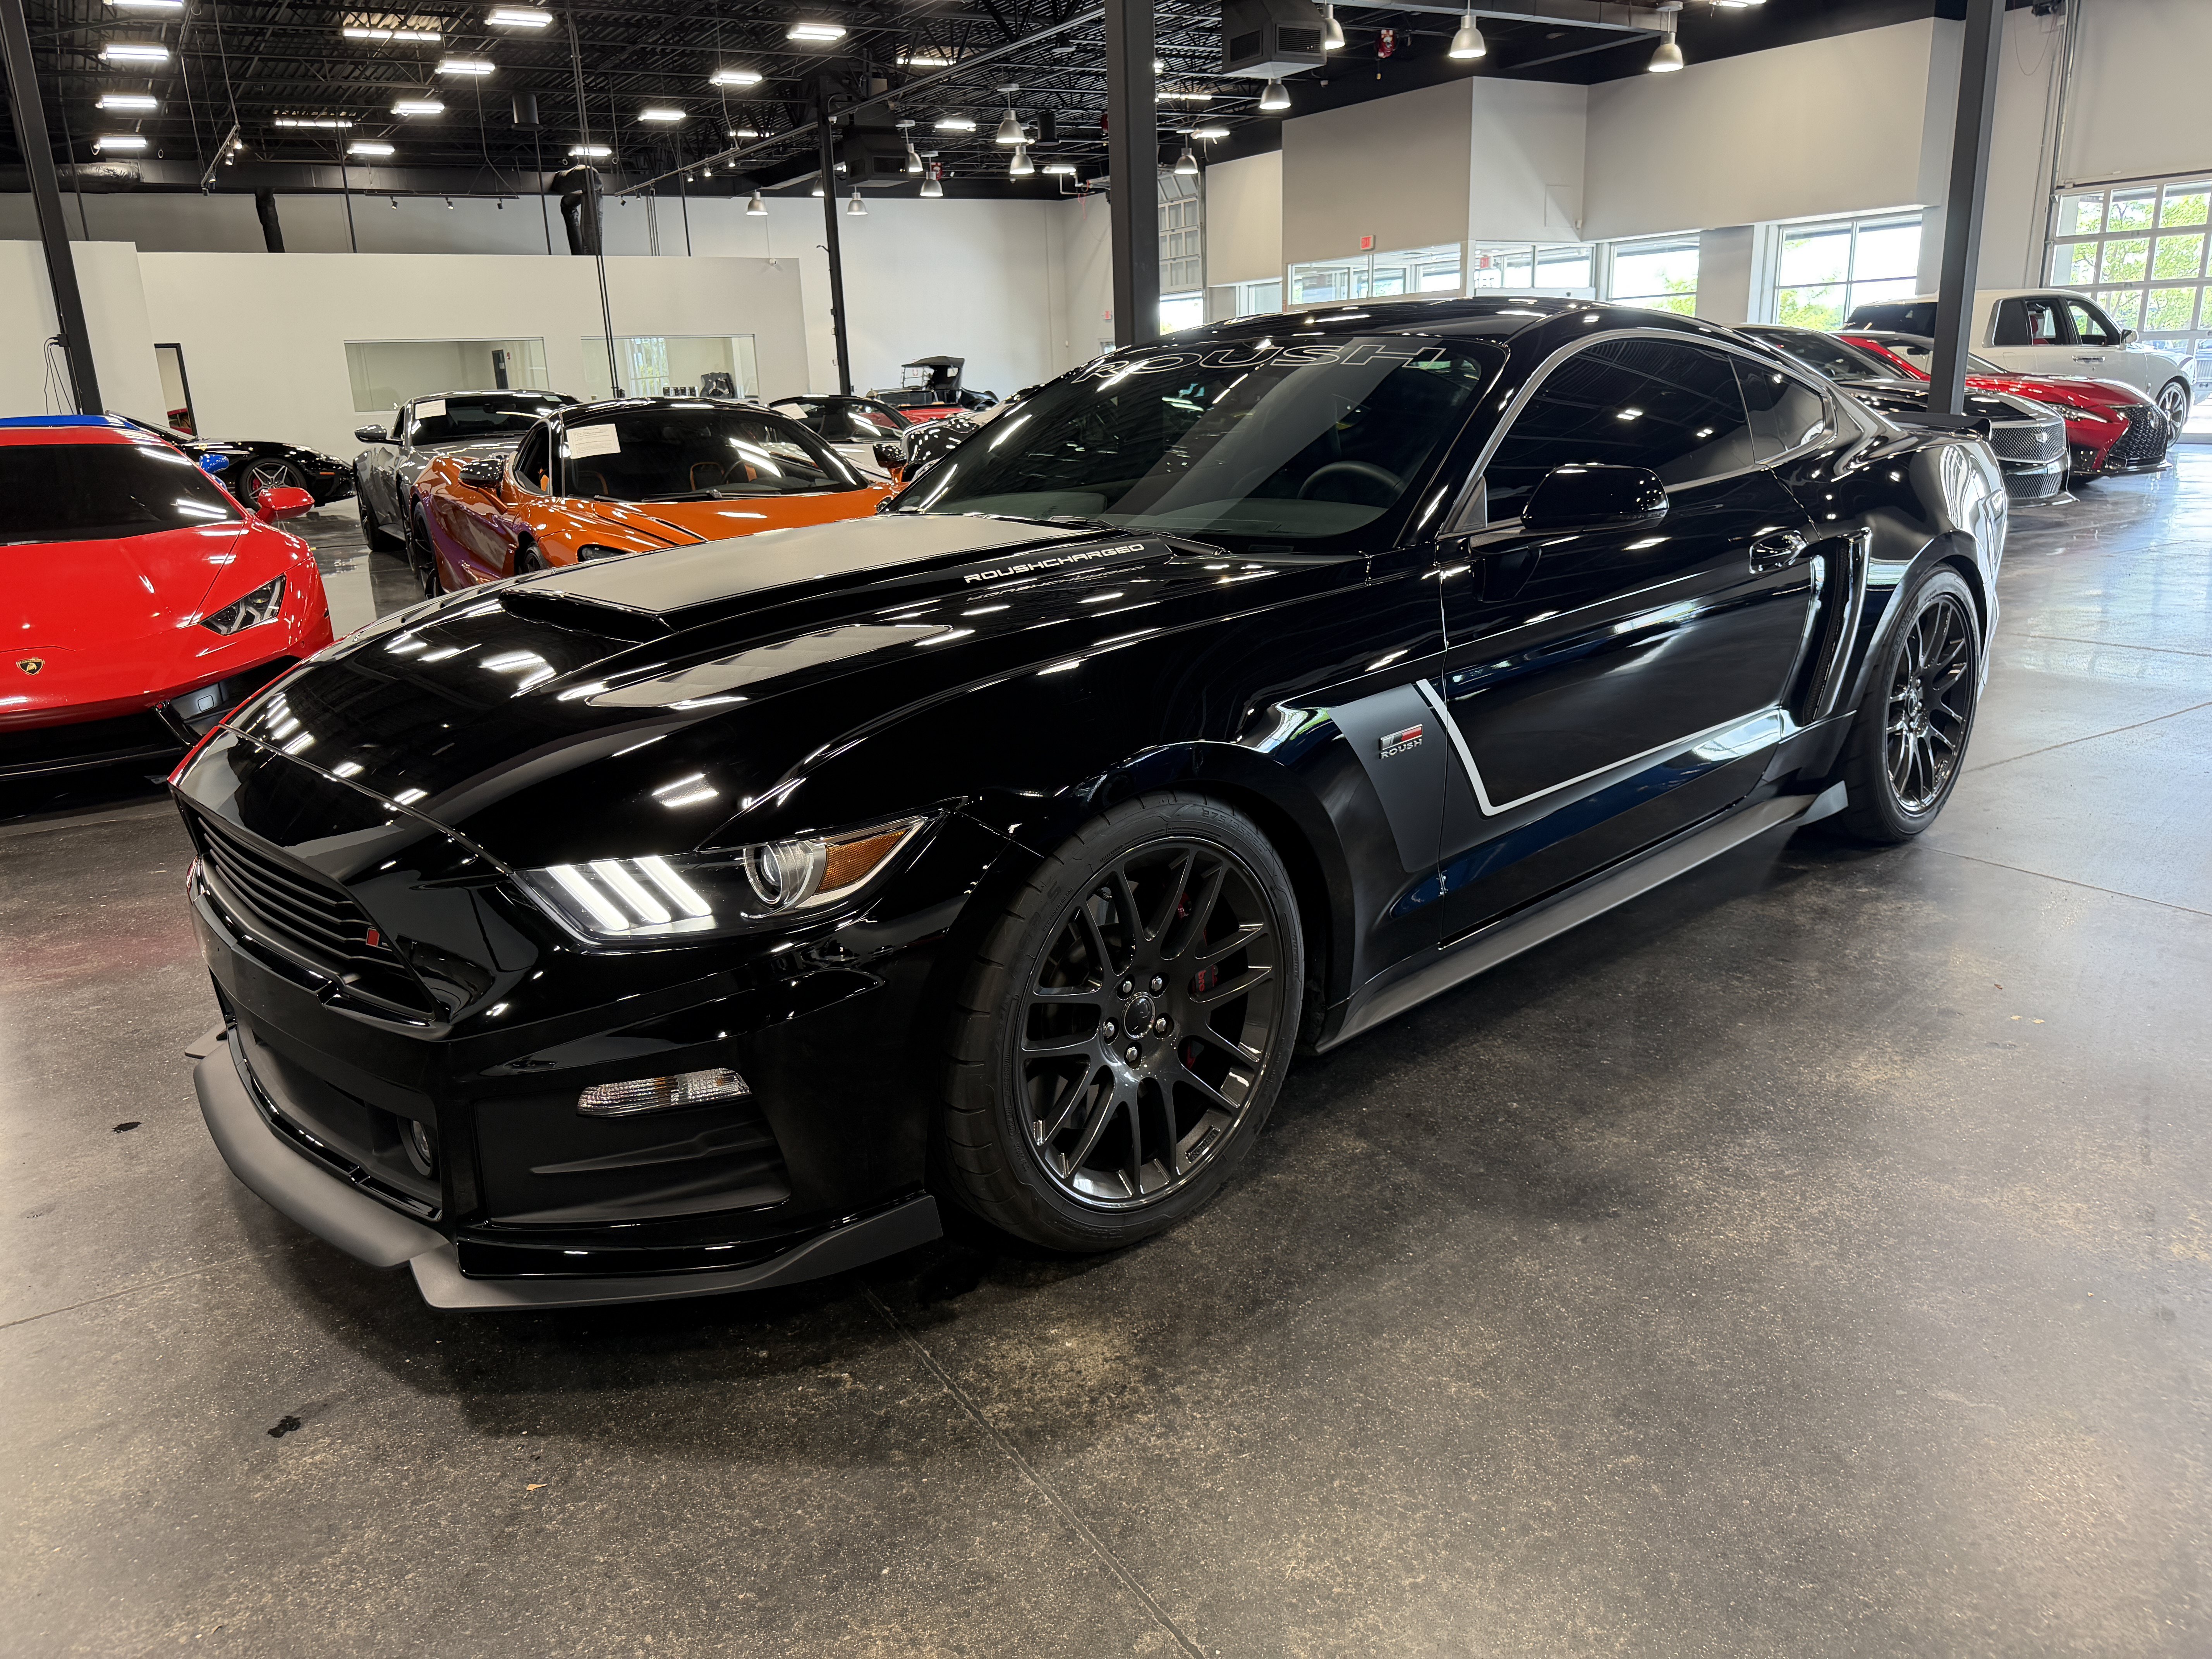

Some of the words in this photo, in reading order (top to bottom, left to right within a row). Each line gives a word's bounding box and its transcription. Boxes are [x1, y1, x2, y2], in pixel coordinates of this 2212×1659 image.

[1072, 345, 1447, 383] ROUSH
[964, 544, 1144, 583] ROUSHCHARGED
[1381, 738, 1422, 759] ROUSH
